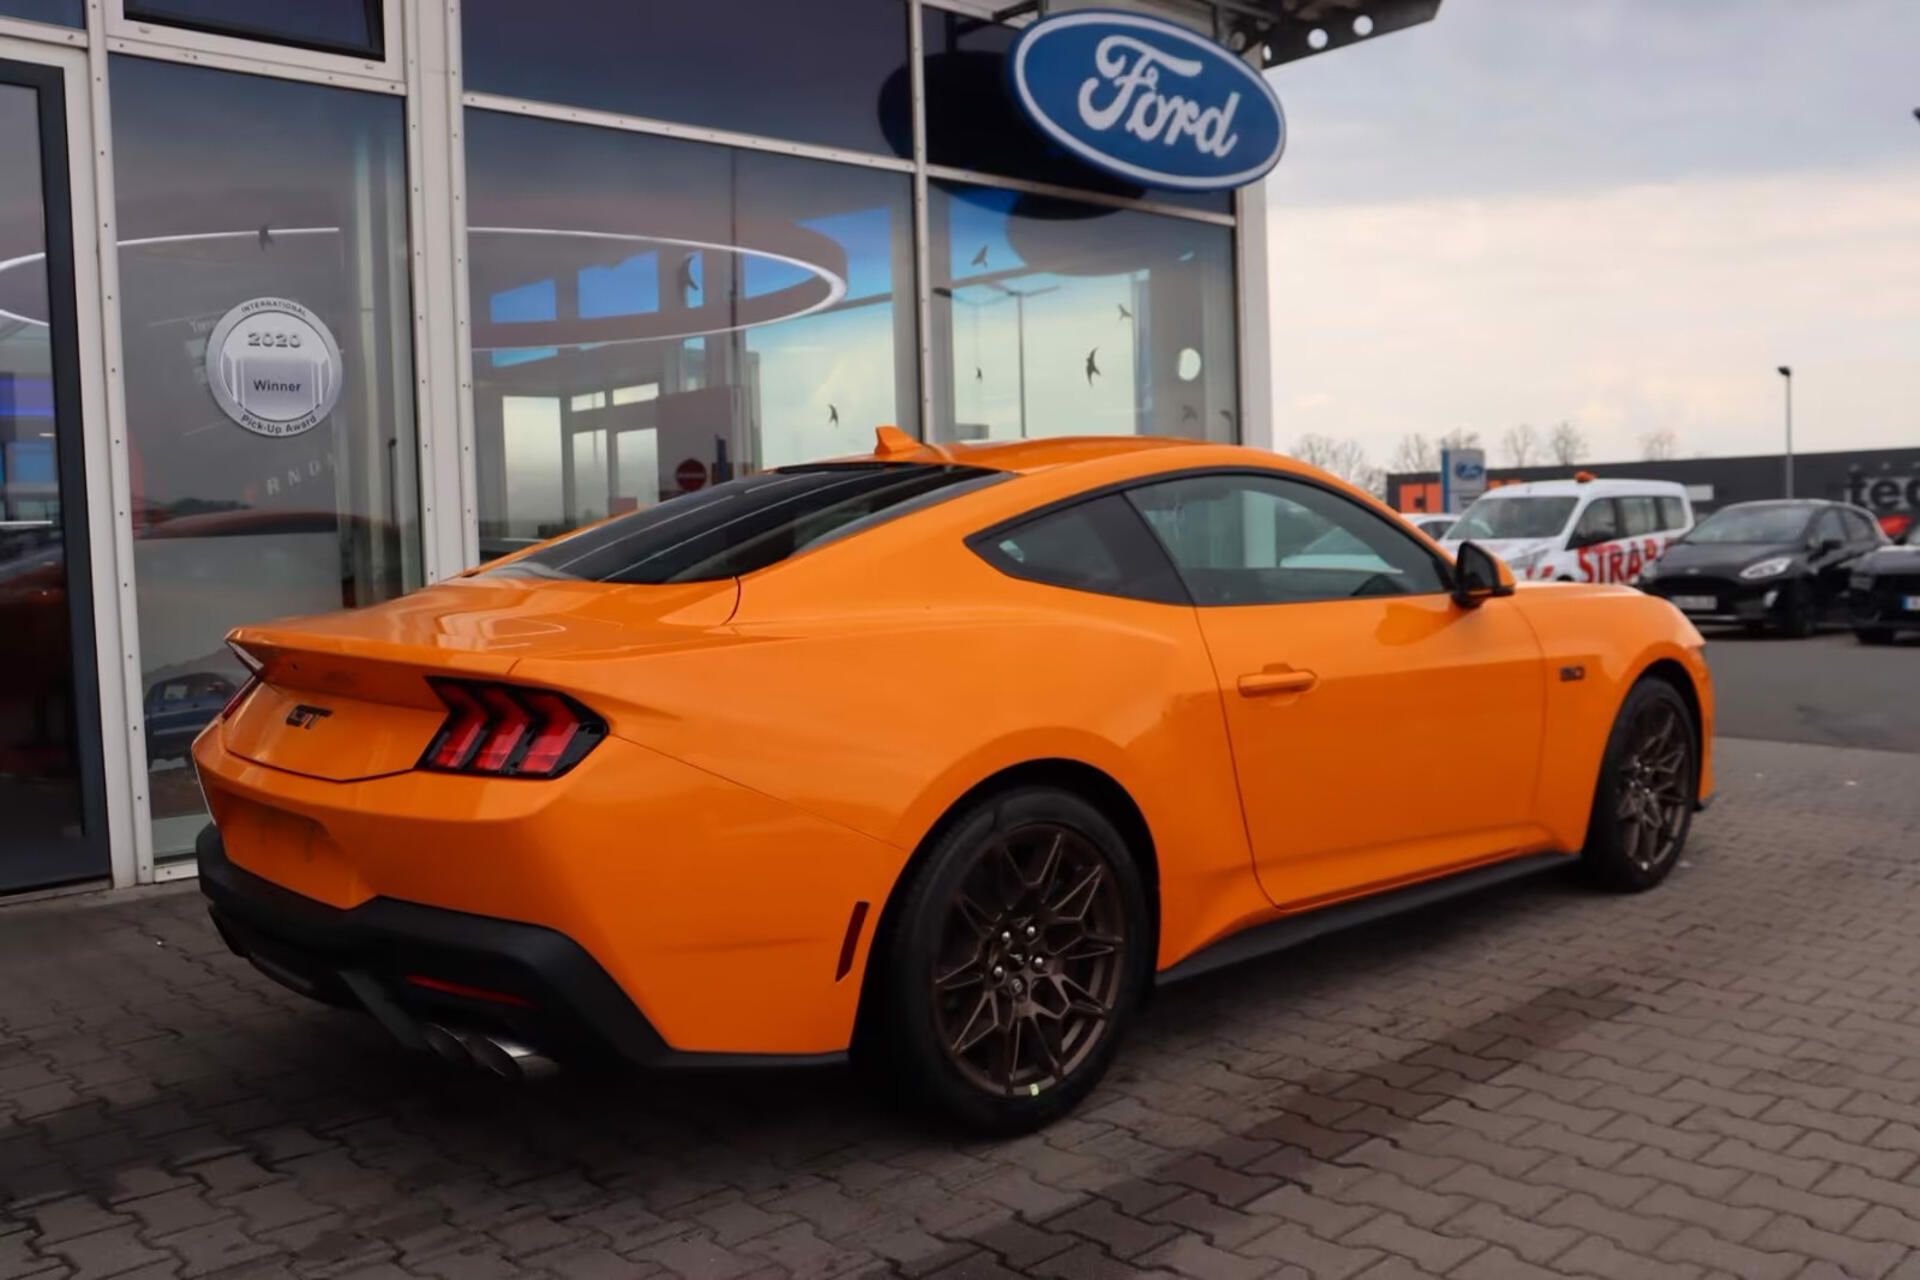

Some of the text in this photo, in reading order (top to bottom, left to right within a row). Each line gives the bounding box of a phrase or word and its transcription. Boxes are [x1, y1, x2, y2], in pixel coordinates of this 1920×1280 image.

[1078, 35, 1240, 157] Ford
[241, 300, 306, 317] INTERNATIONAL
[248, 331, 301, 349] 2020
[253, 379, 302, 392] Winner
[242, 414, 317, 434] Pick-Up Award
[286, 703, 333, 730] GT
